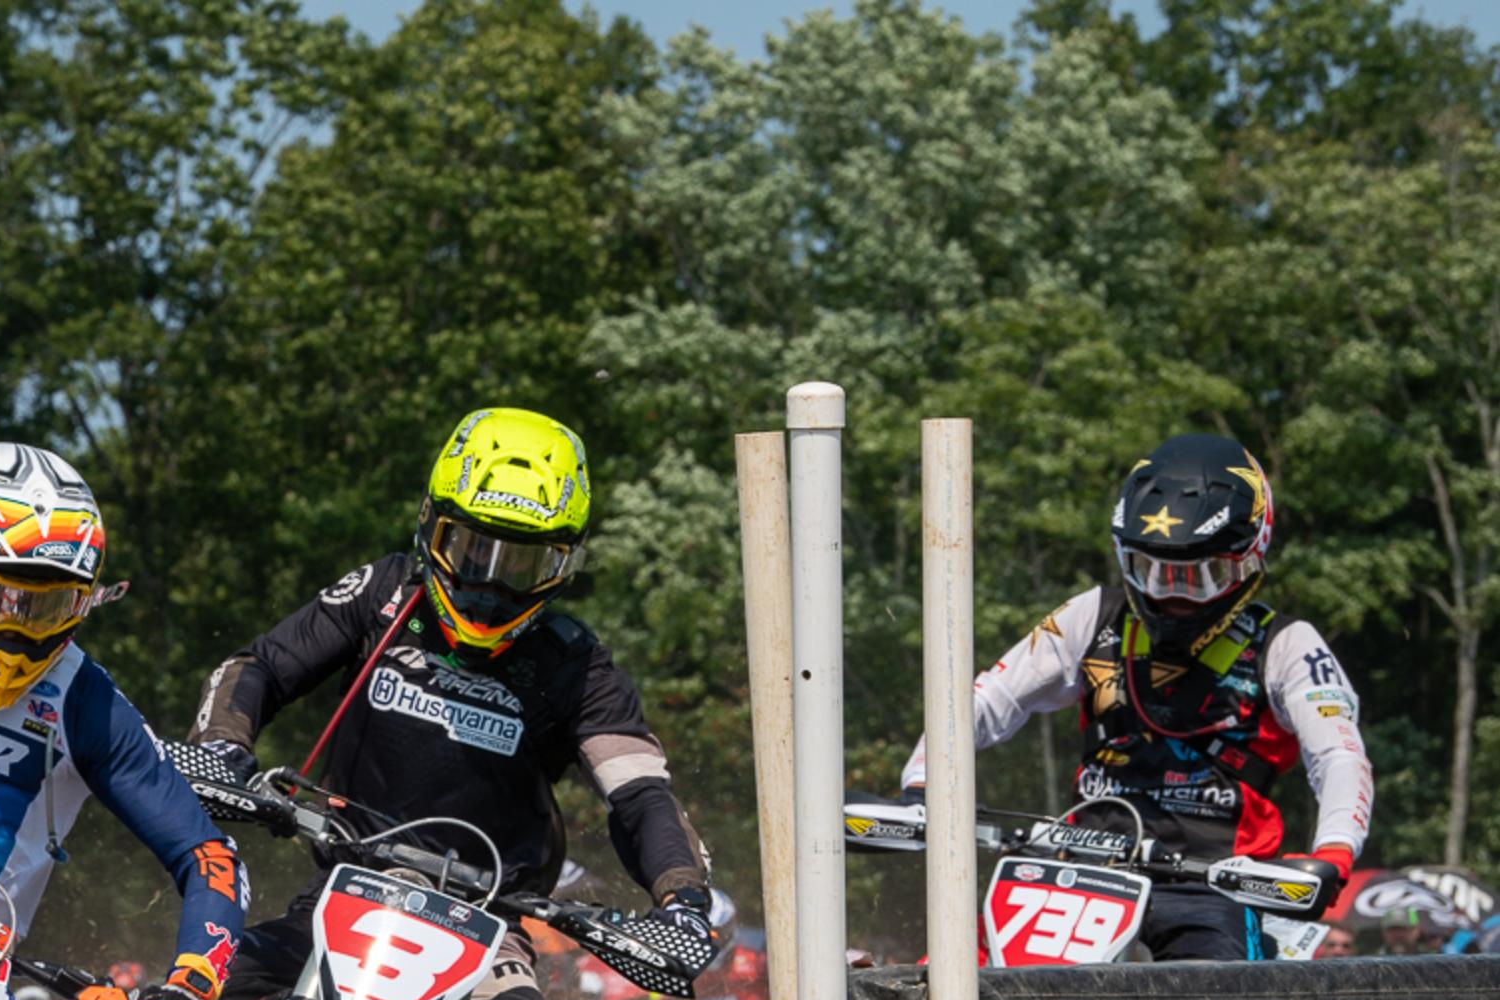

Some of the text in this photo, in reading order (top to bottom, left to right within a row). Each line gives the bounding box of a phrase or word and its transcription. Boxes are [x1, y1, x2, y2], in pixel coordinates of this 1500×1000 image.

[397, 686, 518, 741] Husqvarna
[191, 783, 258, 811] CERBIS
[997, 886, 1126, 963] 739
[586, 929, 668, 968] ACERBIS
